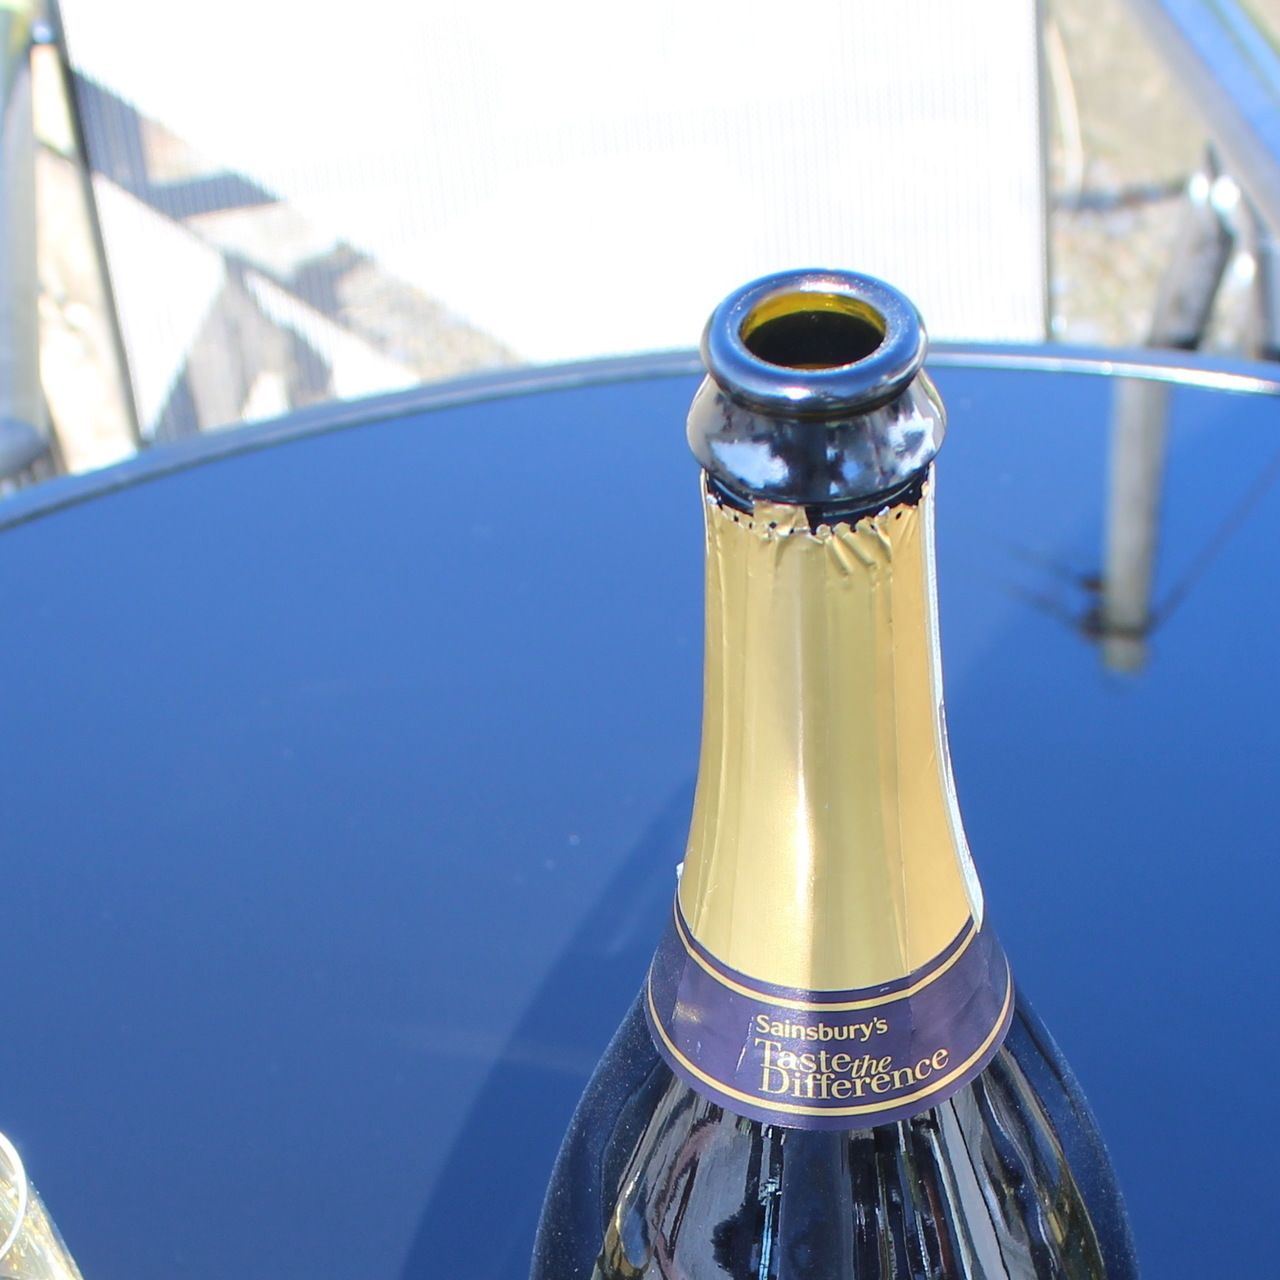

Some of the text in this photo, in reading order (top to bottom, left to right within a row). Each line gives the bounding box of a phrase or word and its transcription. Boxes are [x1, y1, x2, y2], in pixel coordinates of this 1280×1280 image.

[755, 1014, 888, 1042] Sainsbury's
[755, 1037, 893, 1079] Taste the
[758, 1047, 949, 1100] Difference
